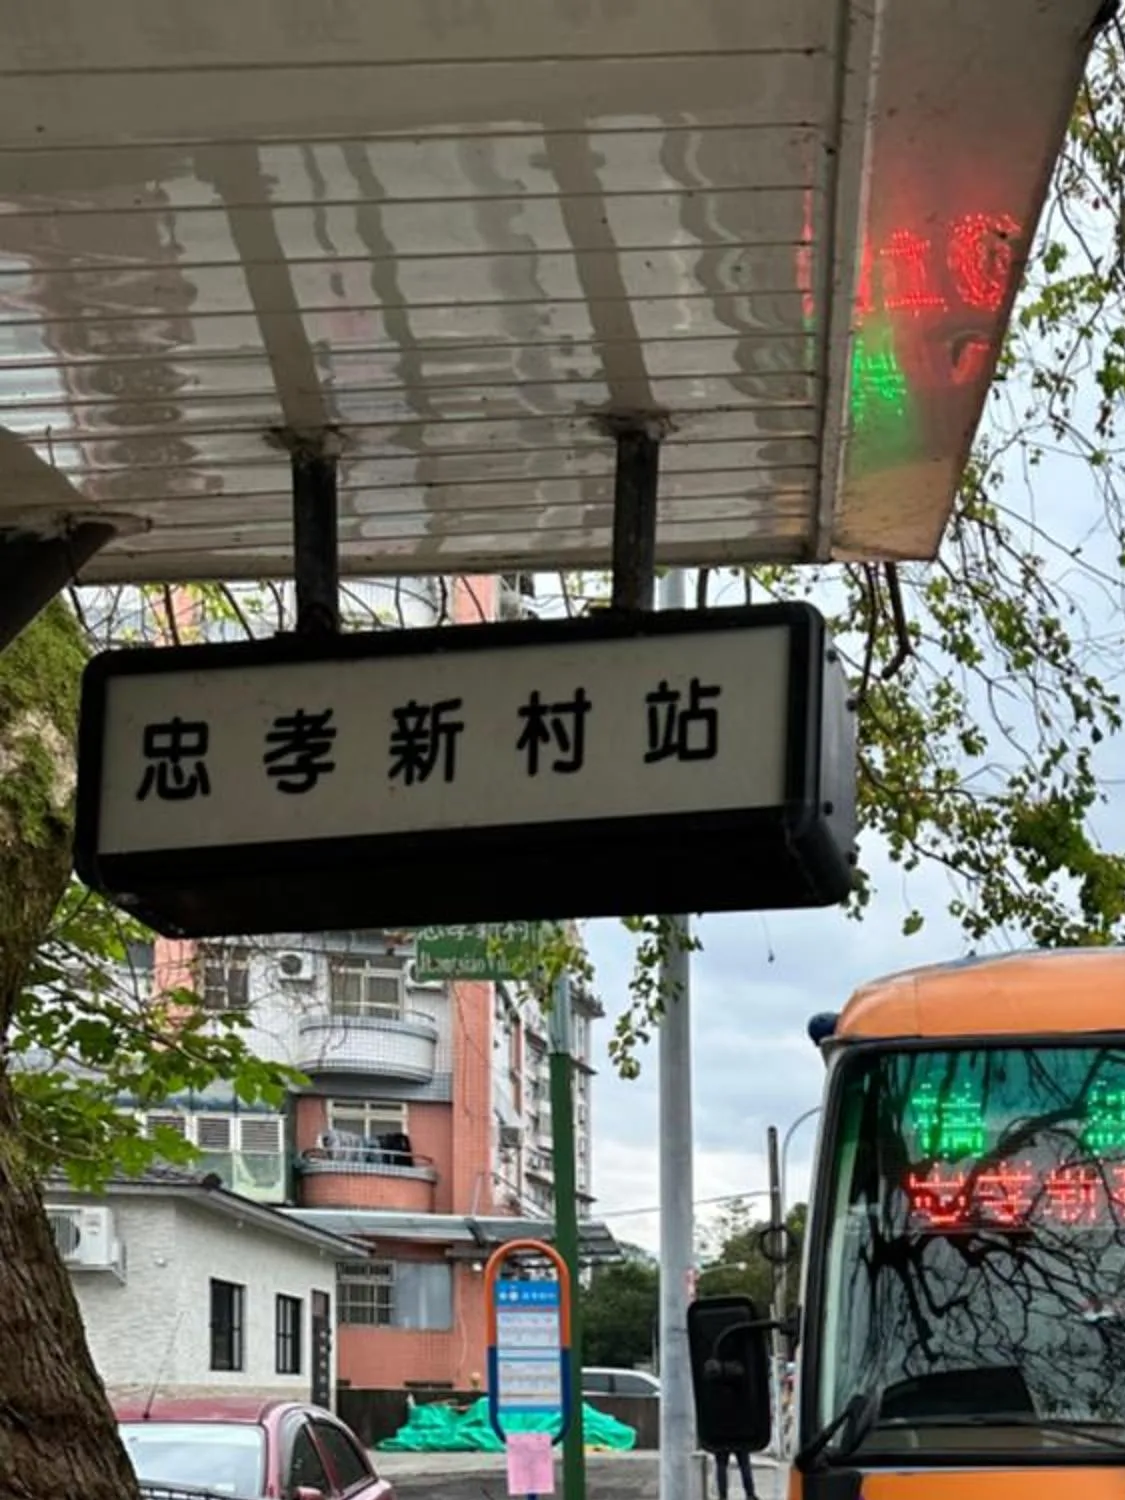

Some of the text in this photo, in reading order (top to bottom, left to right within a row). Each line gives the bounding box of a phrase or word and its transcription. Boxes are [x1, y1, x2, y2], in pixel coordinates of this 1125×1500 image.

[136, 677, 723, 802] 忠孝新村站
